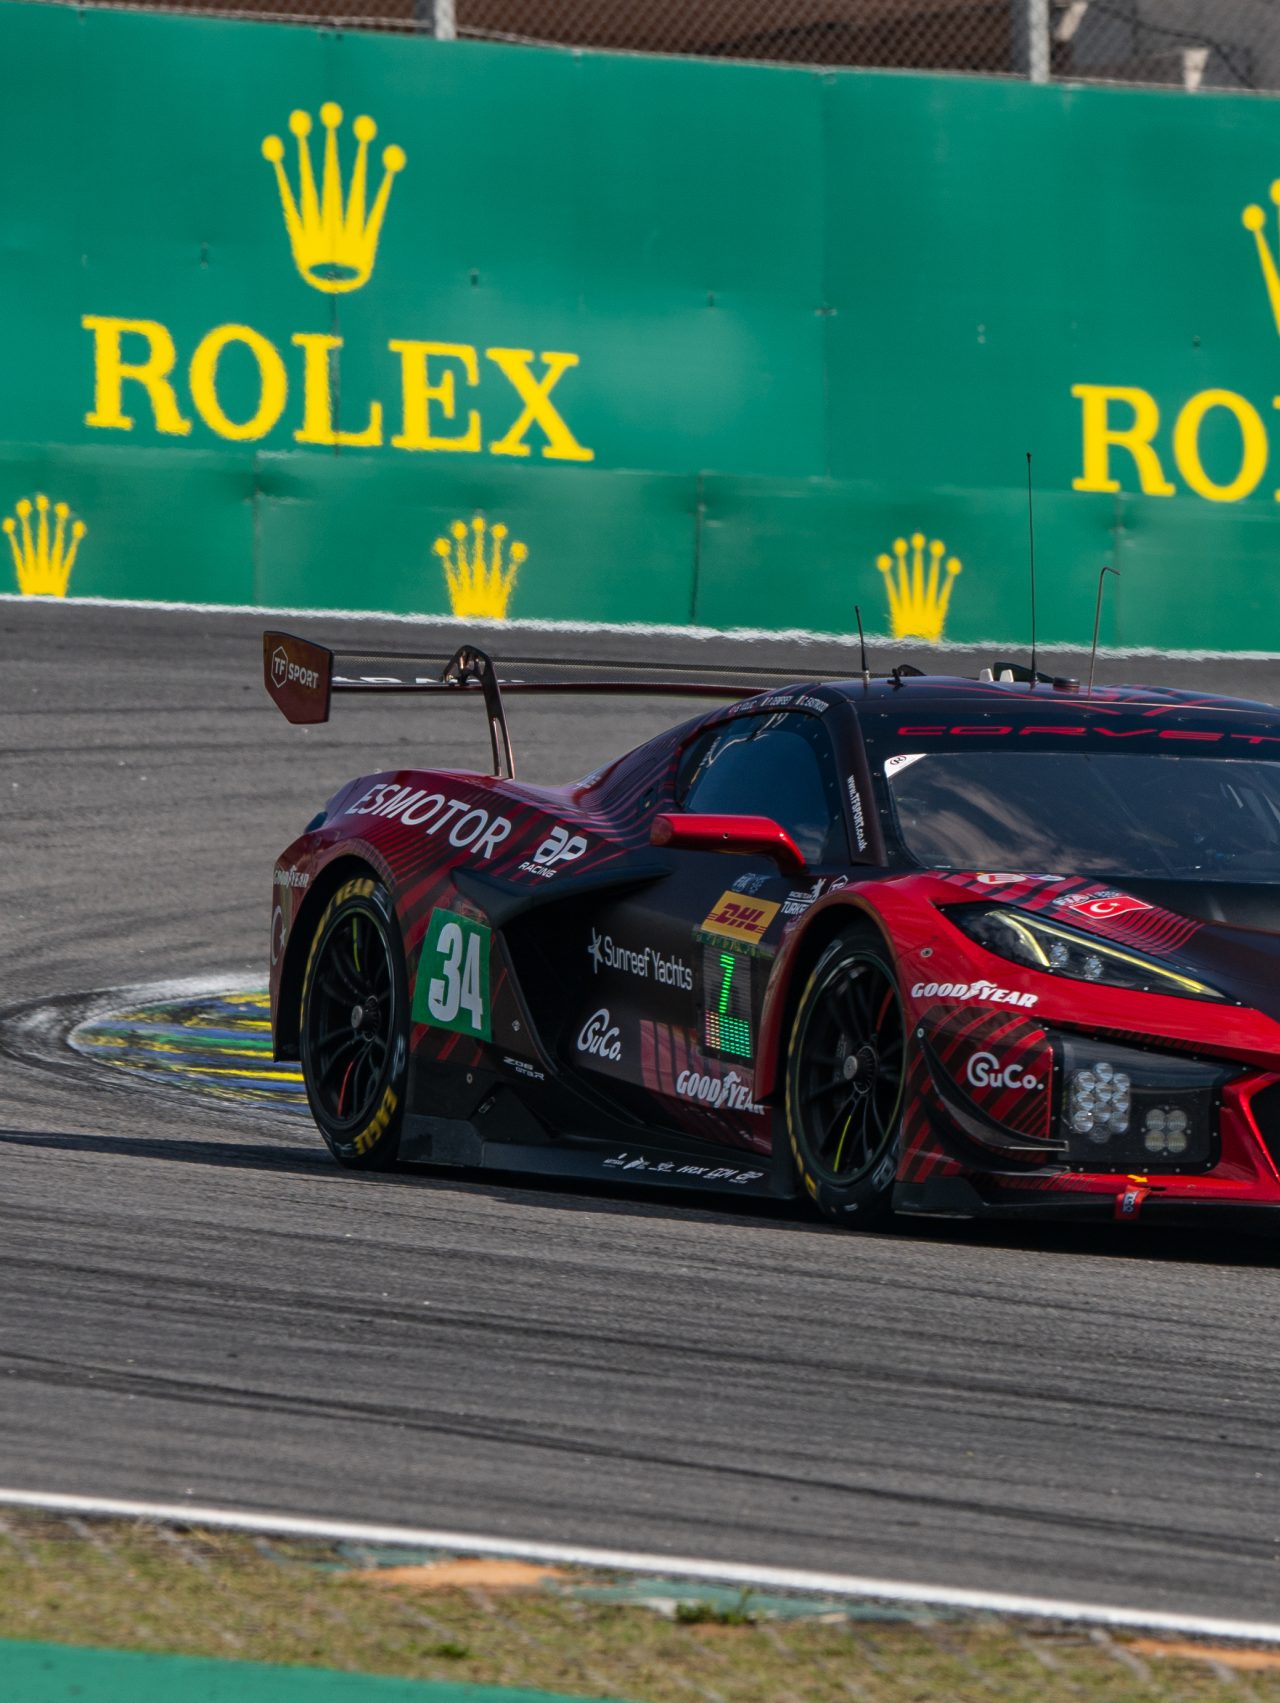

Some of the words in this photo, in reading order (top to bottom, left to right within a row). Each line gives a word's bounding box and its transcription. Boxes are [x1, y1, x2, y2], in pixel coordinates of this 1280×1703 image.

[82, 315, 594, 461] ROLEX
[274, 656, 286, 676] TF
[288, 662, 319, 689] SPORT
[345, 783, 512, 860] ESMOTOR
[518, 861, 558, 879] RACING
[714, 902, 766, 932] DHL
[781, 901, 810, 915] TURKE
[428, 922, 484, 1032] 34
[603, 935, 651, 977] Sunreef
[651, 947, 693, 991] Yachts
[911, 979, 1039, 1008] GOODYEAR
